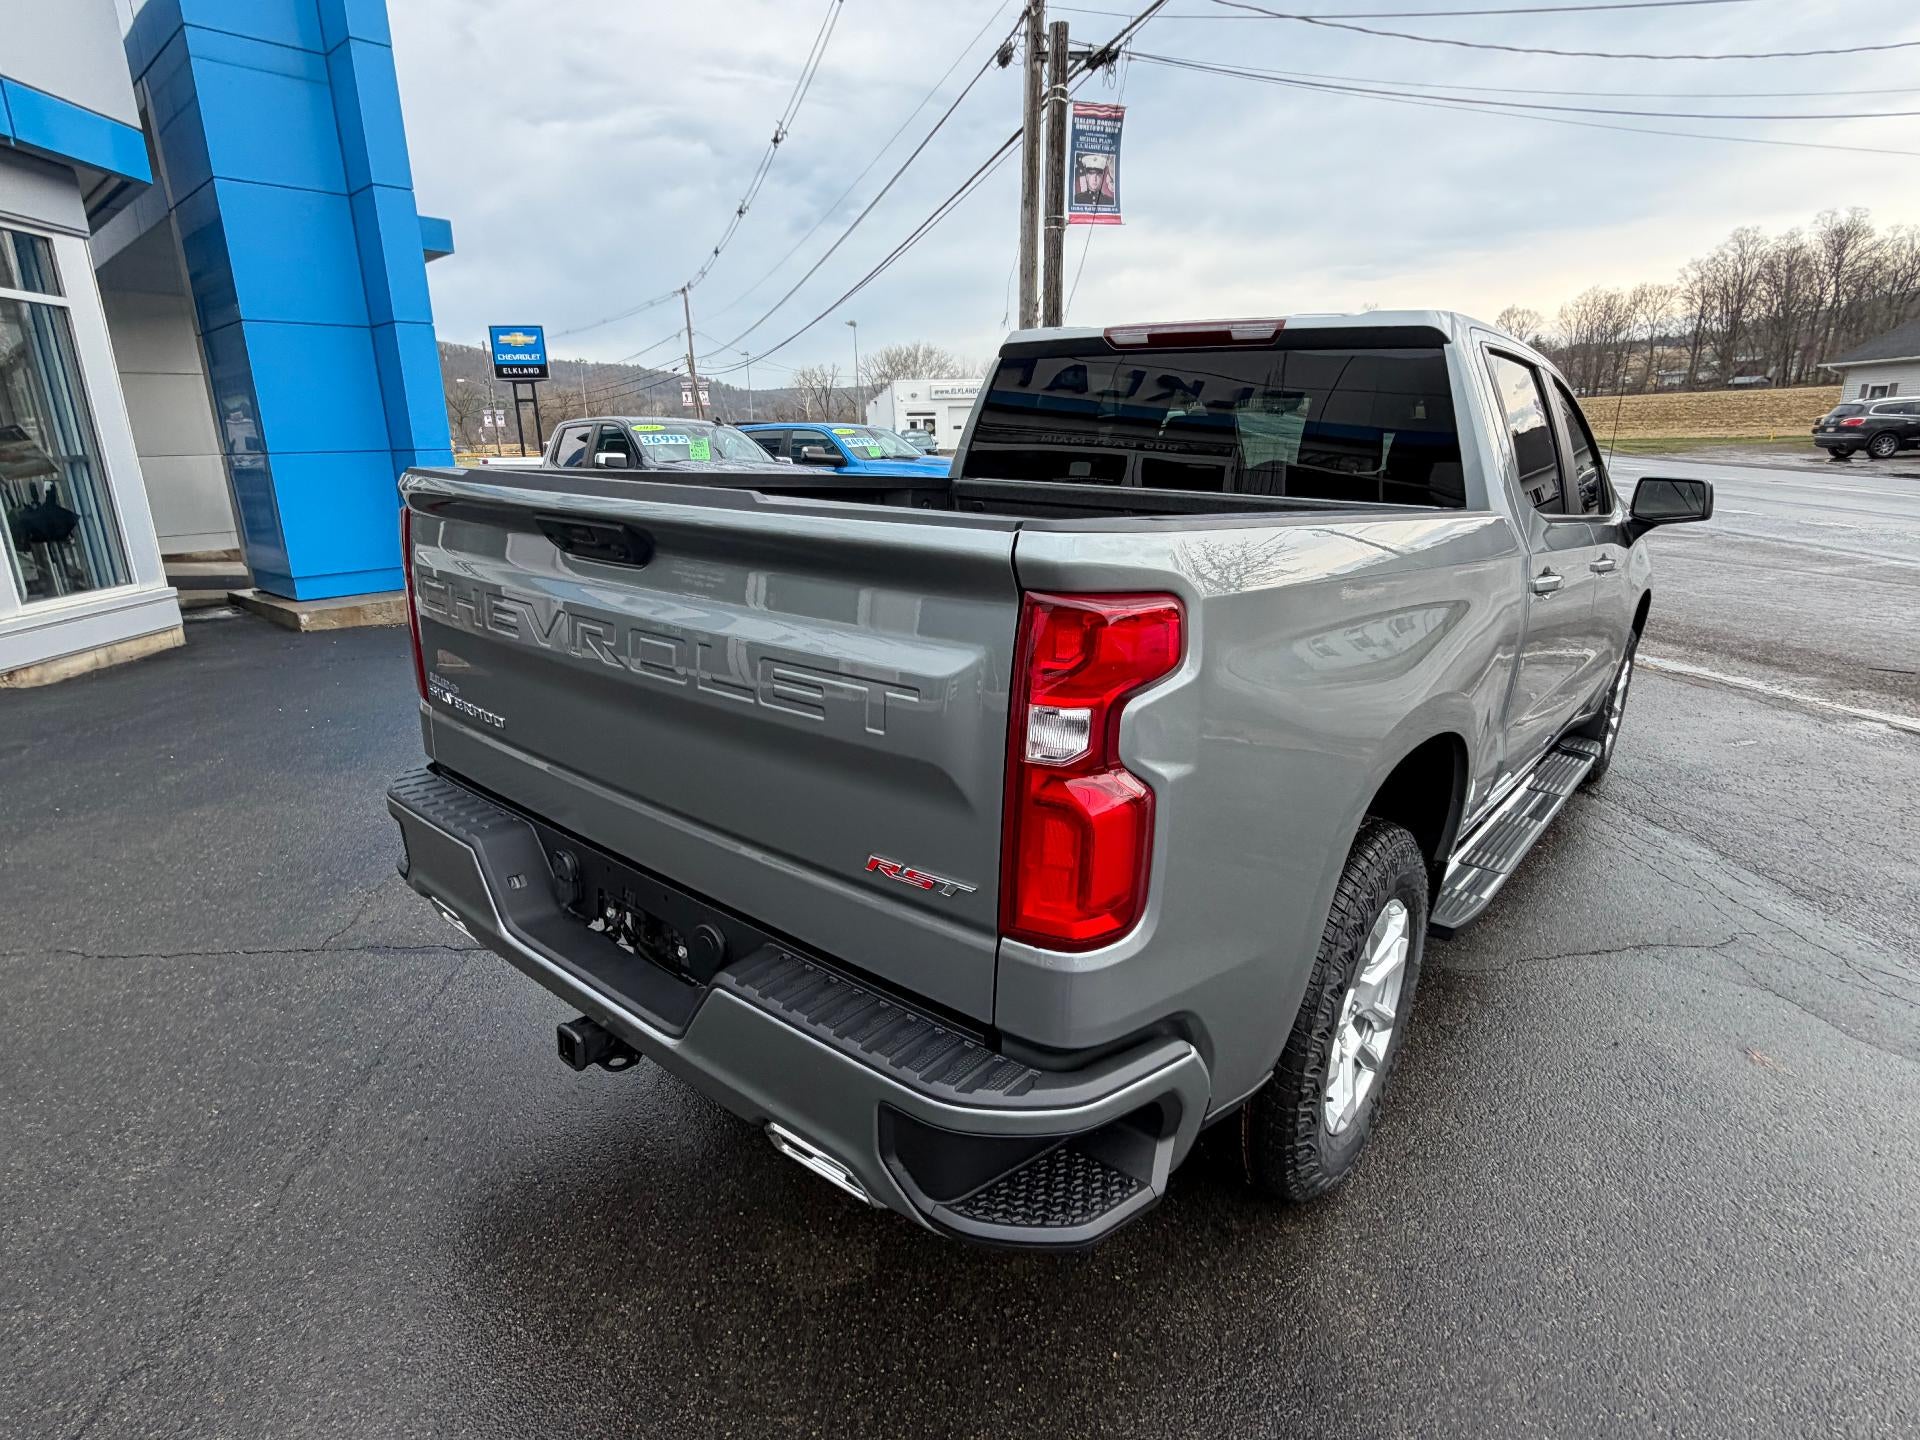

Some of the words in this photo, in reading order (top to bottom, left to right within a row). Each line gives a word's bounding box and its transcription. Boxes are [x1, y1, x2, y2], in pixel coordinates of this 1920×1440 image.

[497, 353, 541, 361] CHEVROLET
[502, 367, 540, 375] ELKLAND
[641, 435, 688, 444] 36995
[420, 573, 920, 735] CHEVROLET
[429, 683, 506, 728] SILVERADO
[864, 854, 977, 897] RST
